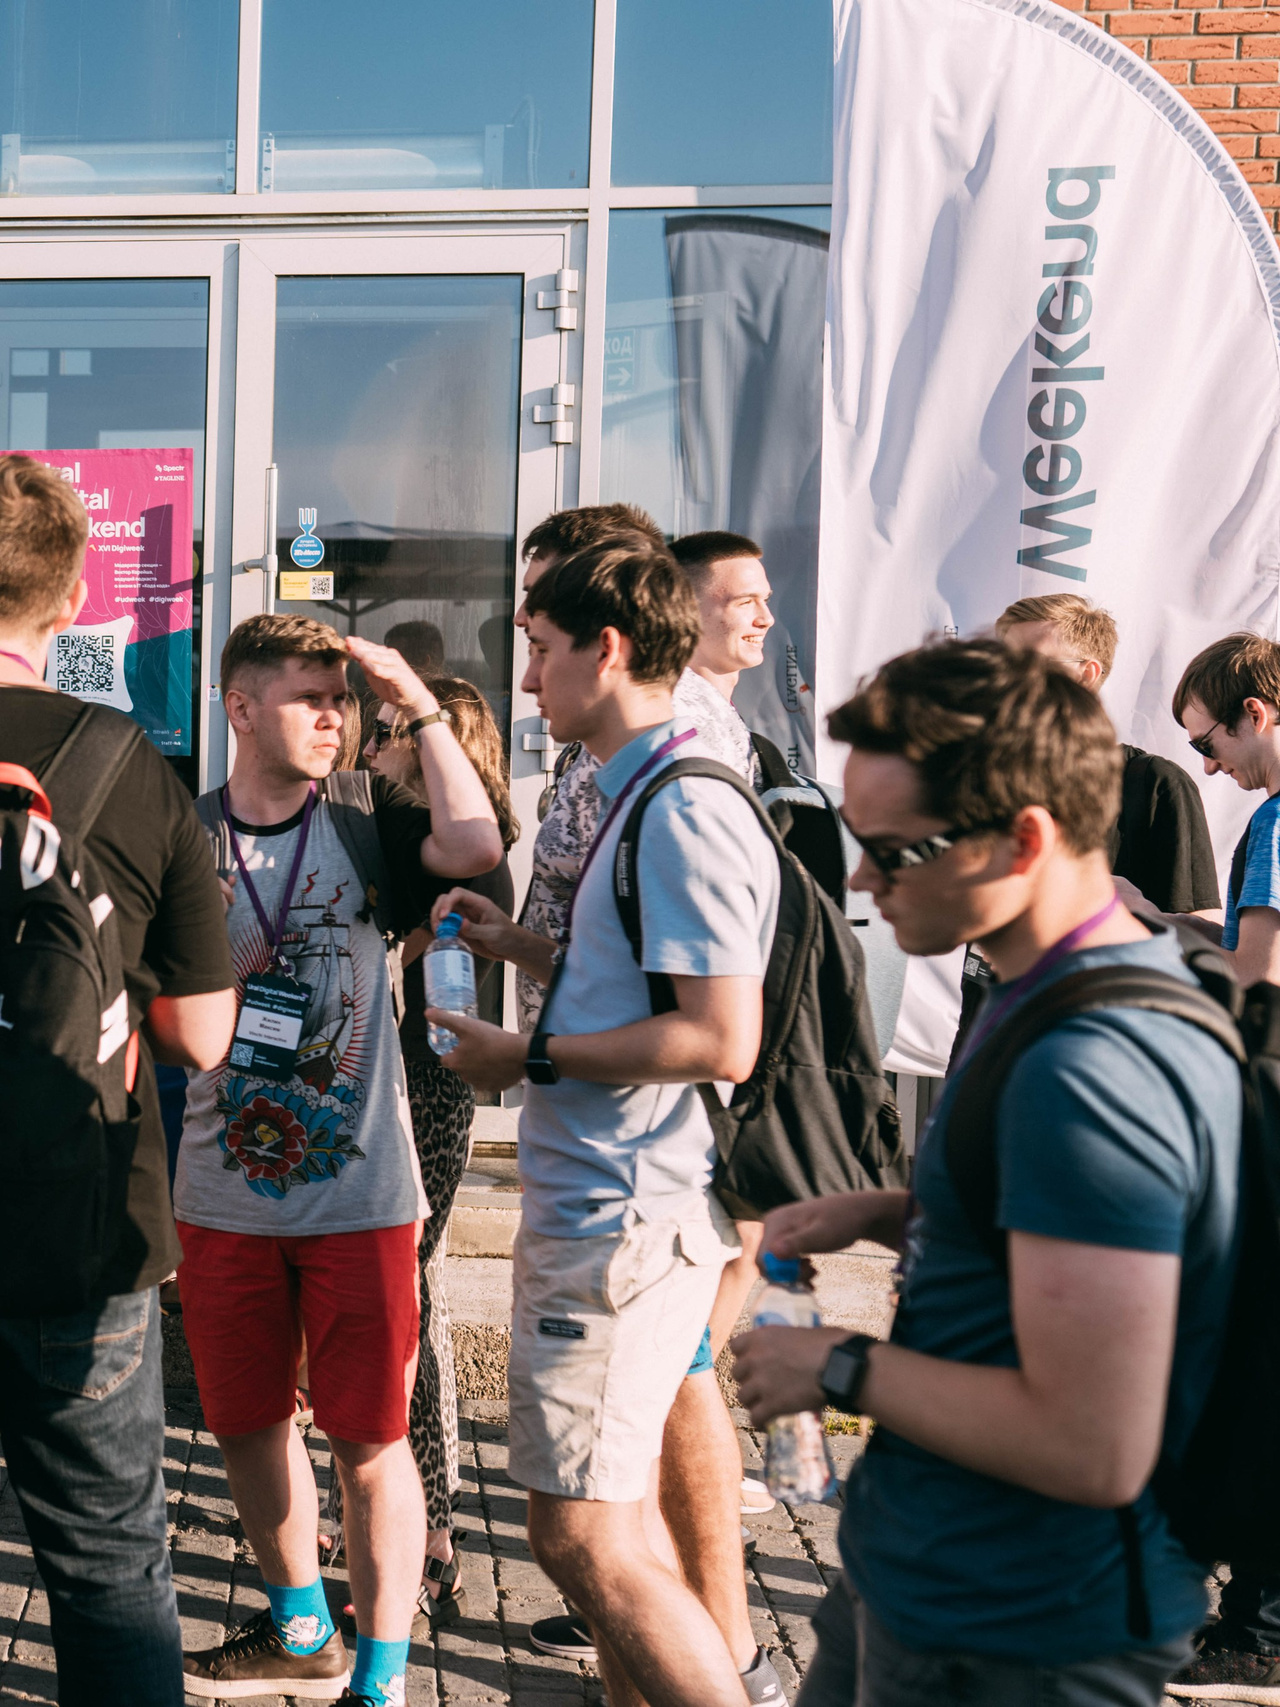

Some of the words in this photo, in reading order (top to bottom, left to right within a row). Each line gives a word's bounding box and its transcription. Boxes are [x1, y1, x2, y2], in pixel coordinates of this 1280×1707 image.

[112, 545, 145, 553] Digiweek
[247, 983, 259, 992] Ural
[259, 985, 278, 996] Digital
[278, 990, 306, 1002] Weekend
